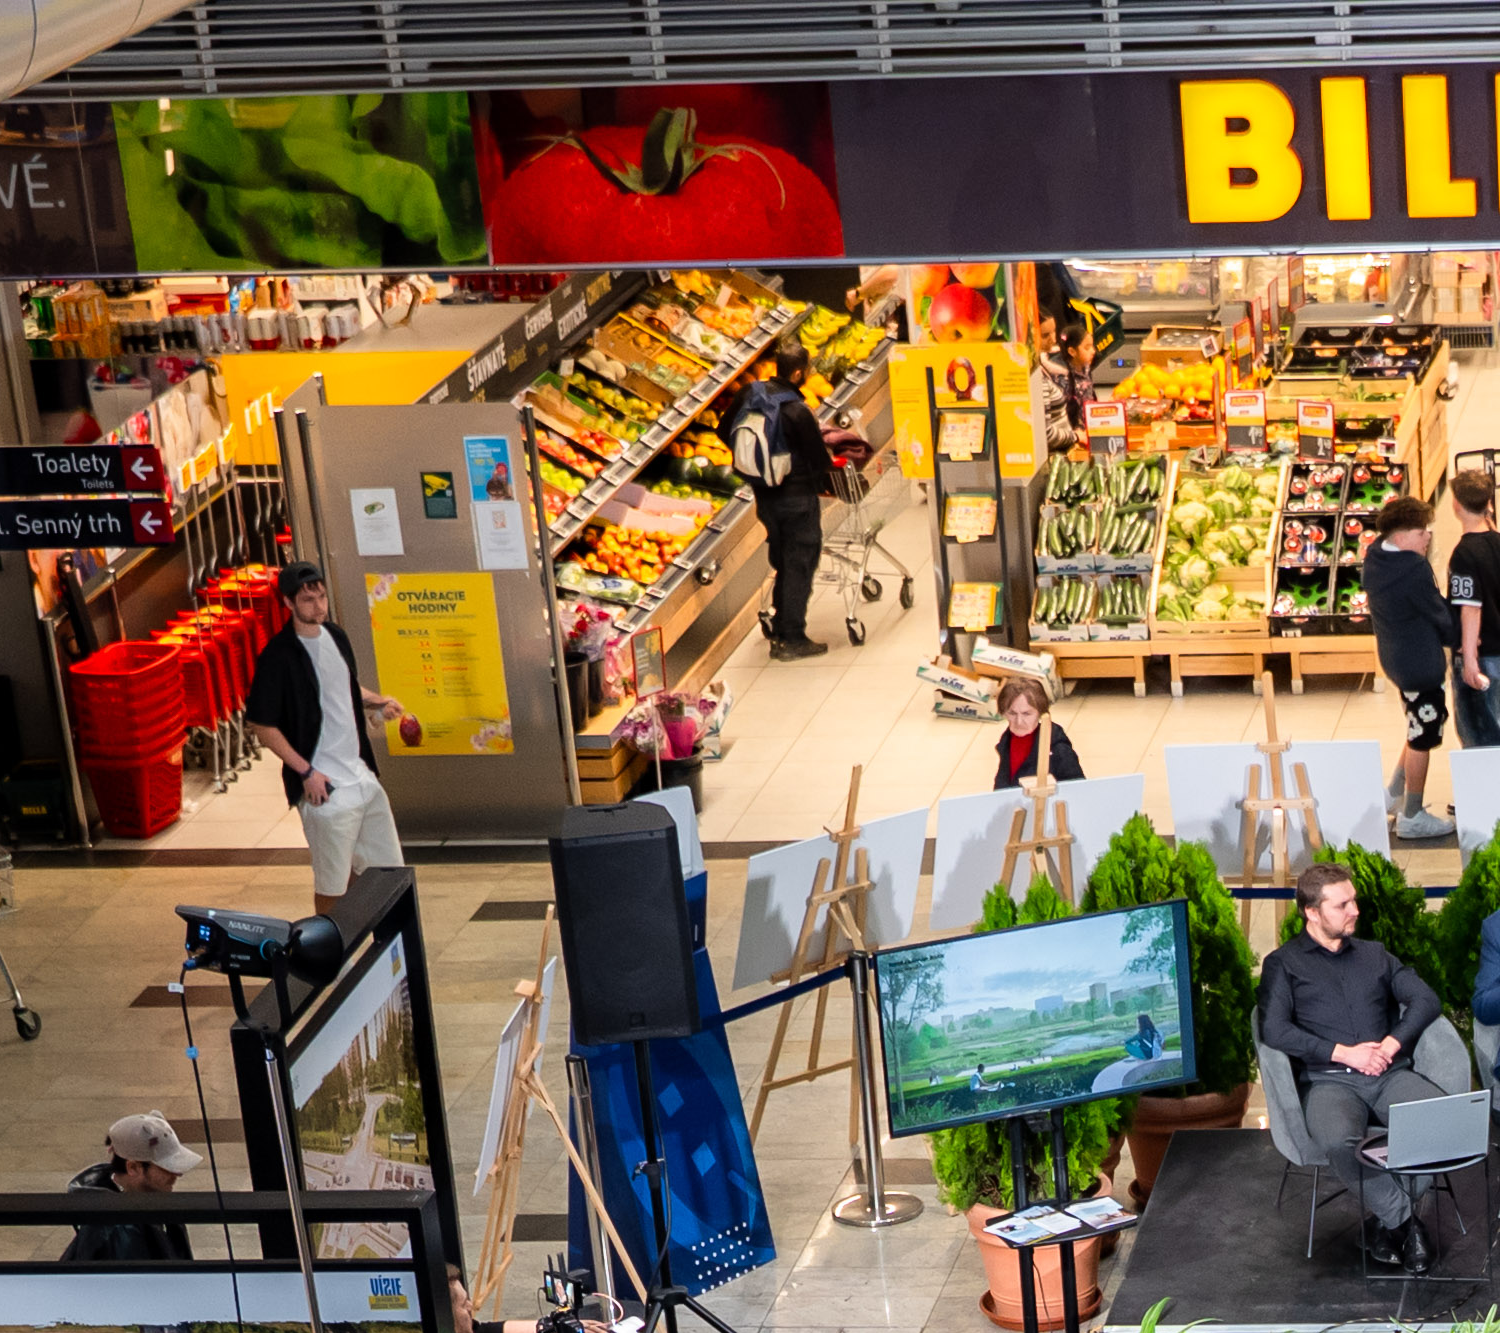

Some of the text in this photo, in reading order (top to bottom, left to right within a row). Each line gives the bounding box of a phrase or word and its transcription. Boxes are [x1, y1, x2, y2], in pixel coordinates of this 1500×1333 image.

[32, 452, 110, 477] Toalety
[81, 478, 115, 489] Toilets
[17, 512, 83, 541] Senný
[89, 513, 122, 534] trh
[1451, 575, 1474, 599] 36
[397, 589, 466, 602] OTVÁRACIE
[408, 602, 457, 614] HODINY
[228, 920, 267, 934] NANLITE
